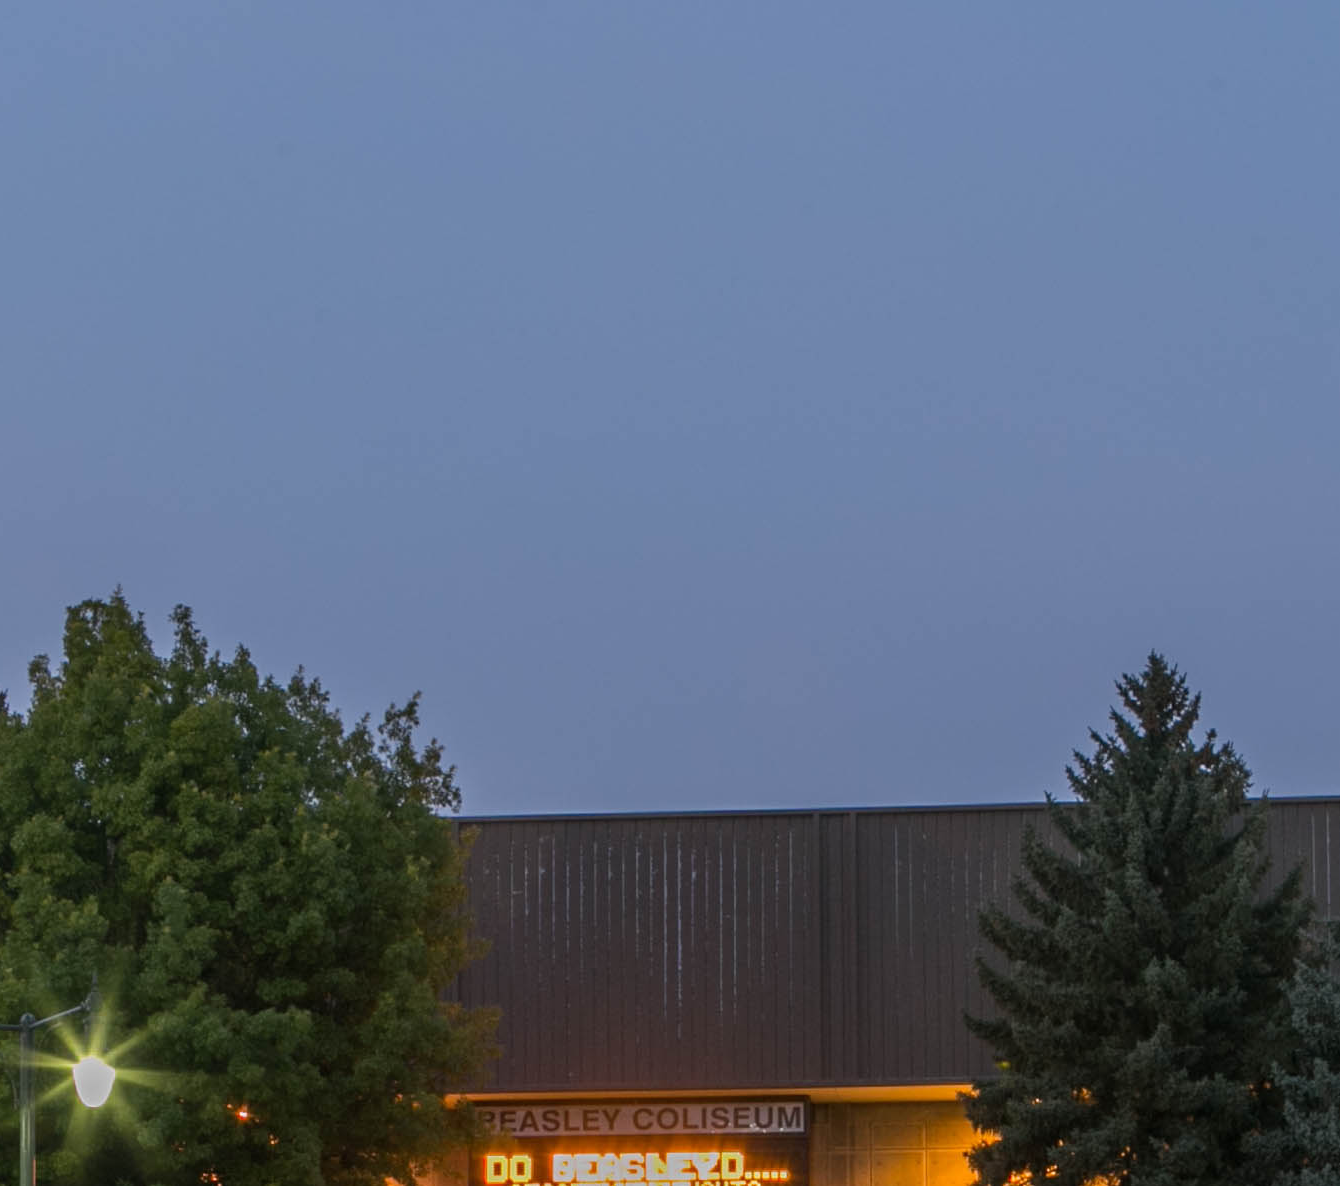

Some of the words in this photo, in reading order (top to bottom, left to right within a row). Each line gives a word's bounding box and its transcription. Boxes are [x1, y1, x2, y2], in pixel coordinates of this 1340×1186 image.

[482, 1109, 620, 1133] BEASLEY
[632, 1105, 802, 1131] COLISEUM
[486, 1154, 532, 1183] DO
